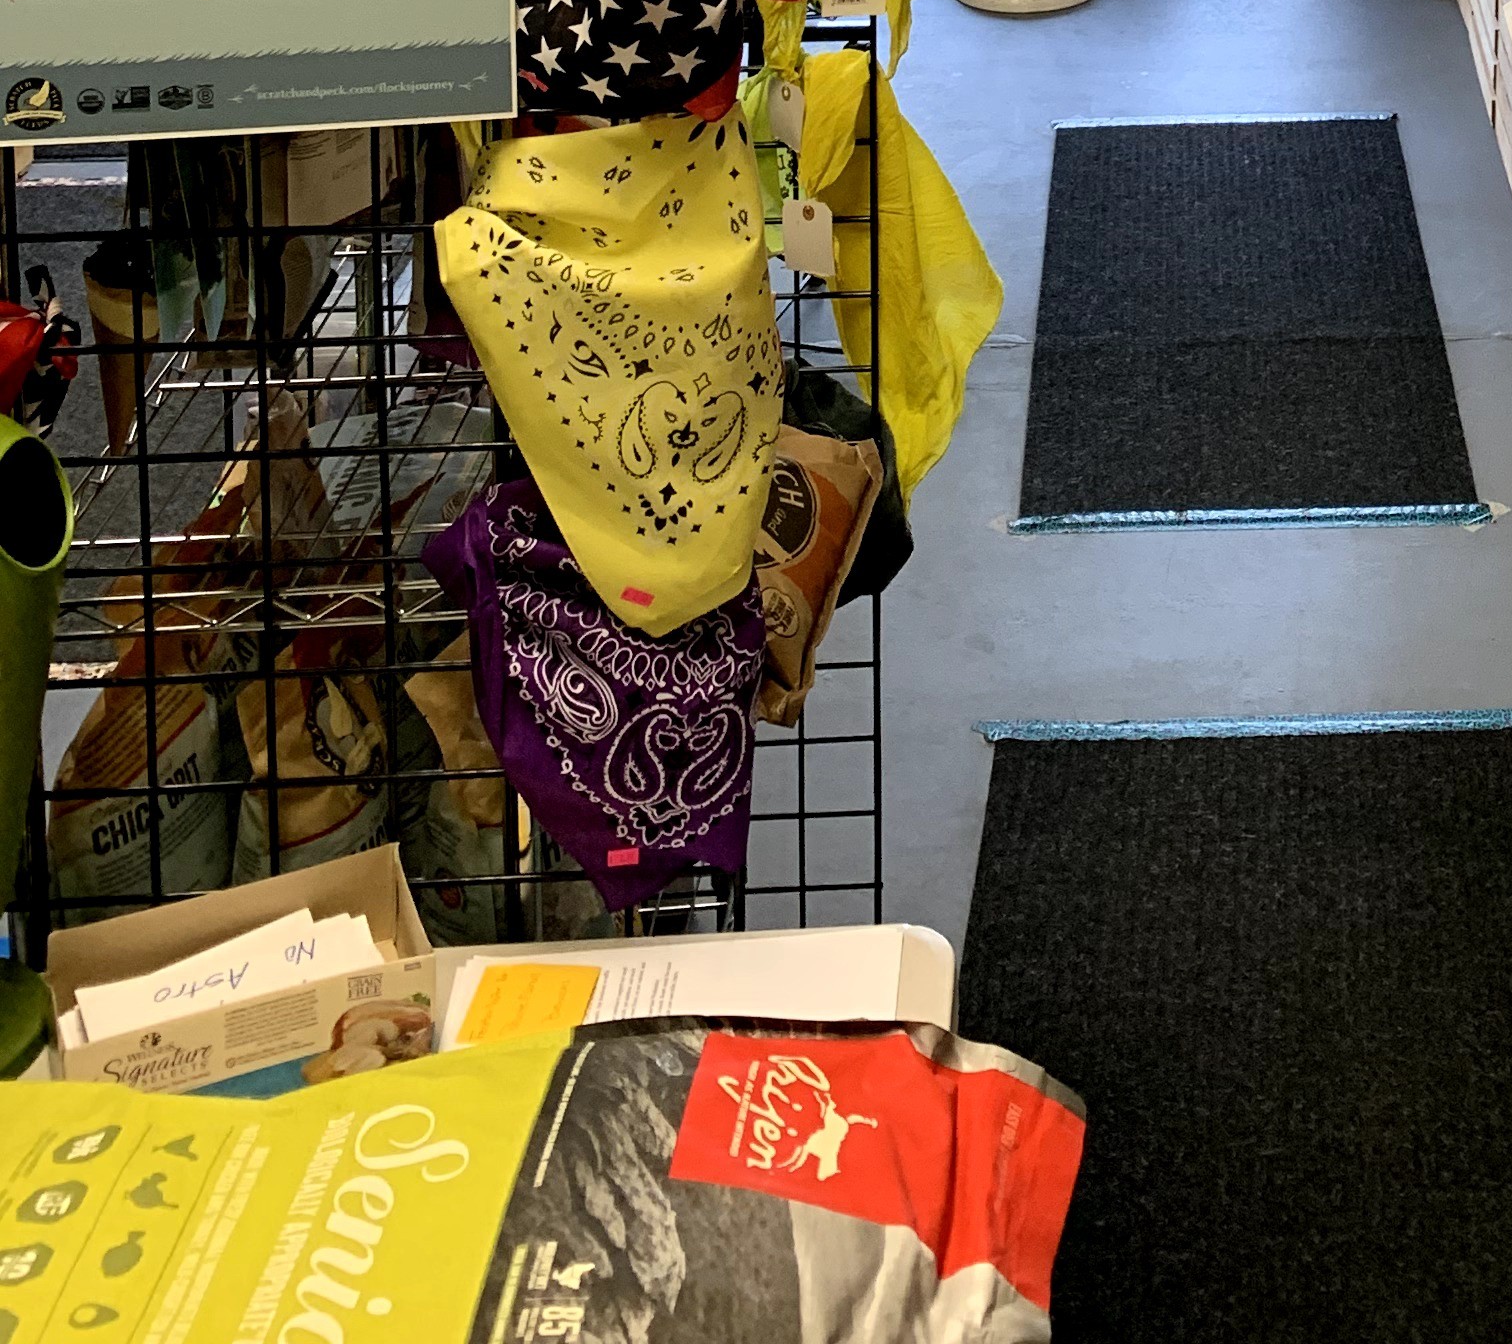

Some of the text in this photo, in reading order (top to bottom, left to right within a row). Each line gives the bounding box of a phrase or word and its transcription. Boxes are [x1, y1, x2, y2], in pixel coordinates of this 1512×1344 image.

[91, 795, 165, 856] CHIC
[154, 938, 316, 1004] No Astro
[347, 973, 383, 989] GRAIN
[348, 985, 383, 1000] FREE
[103, 1043, 214, 1084] Signature
[278, 1103, 470, 1344] Senio
